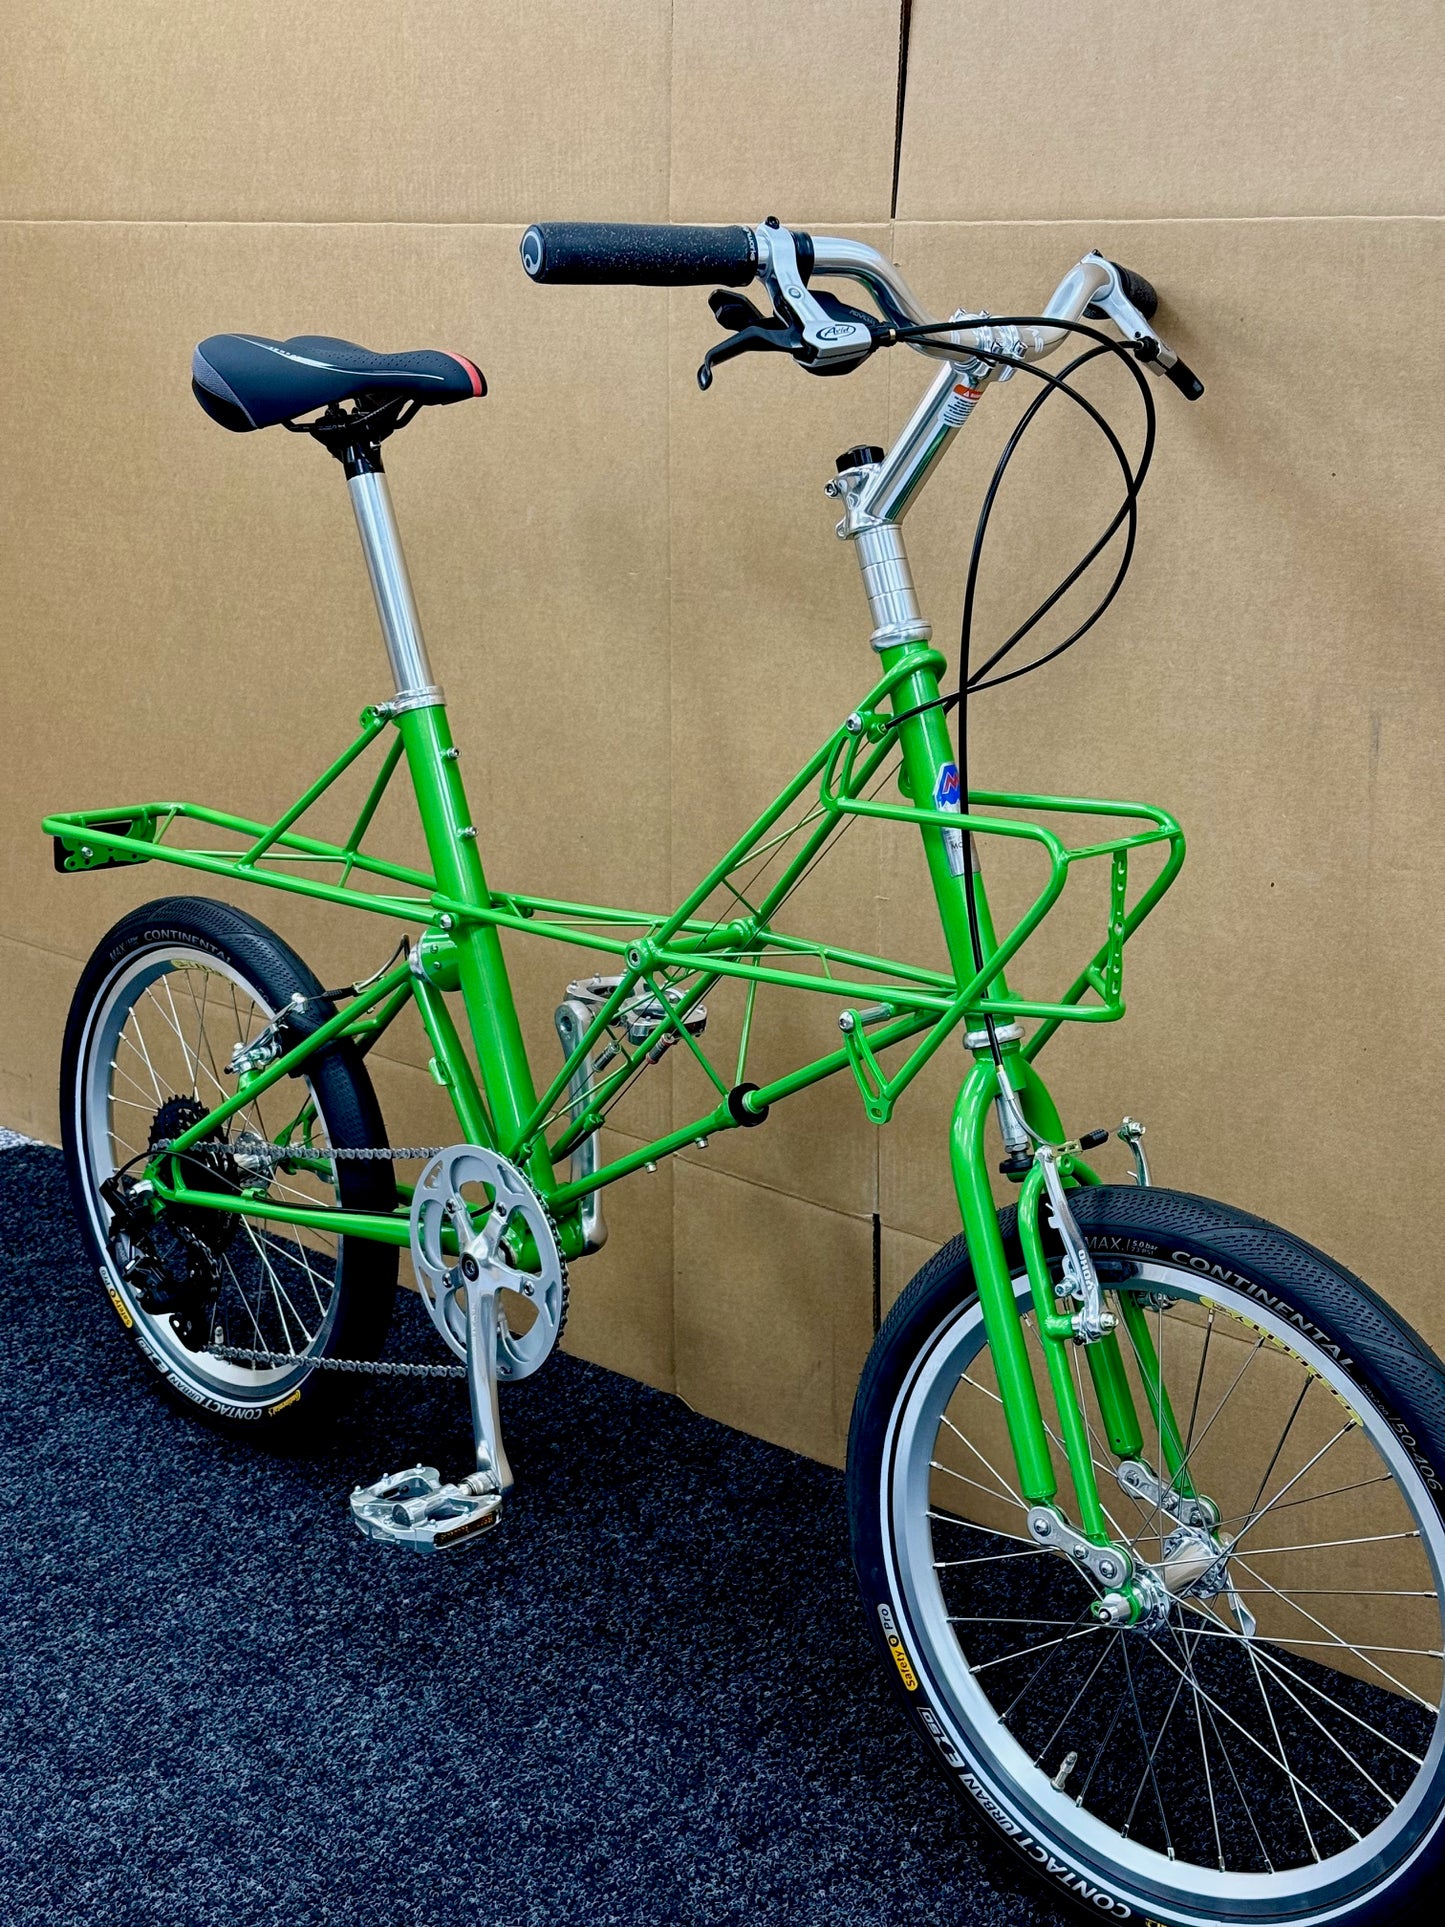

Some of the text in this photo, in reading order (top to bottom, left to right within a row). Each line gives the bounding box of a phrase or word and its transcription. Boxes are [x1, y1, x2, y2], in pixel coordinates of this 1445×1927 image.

[144, 929, 232, 964] CONTINENTAL
[1172, 1251, 1354, 1373] CONTINENTAL
[169, 1375, 203, 1402] URBAN
[201, 1401, 263, 1420] CONTACT
[881, 1608, 916, 1687] Safety Pro
[963, 1776, 1016, 1835] URBAN
[1013, 1837, 1132, 1919] CONTACT
